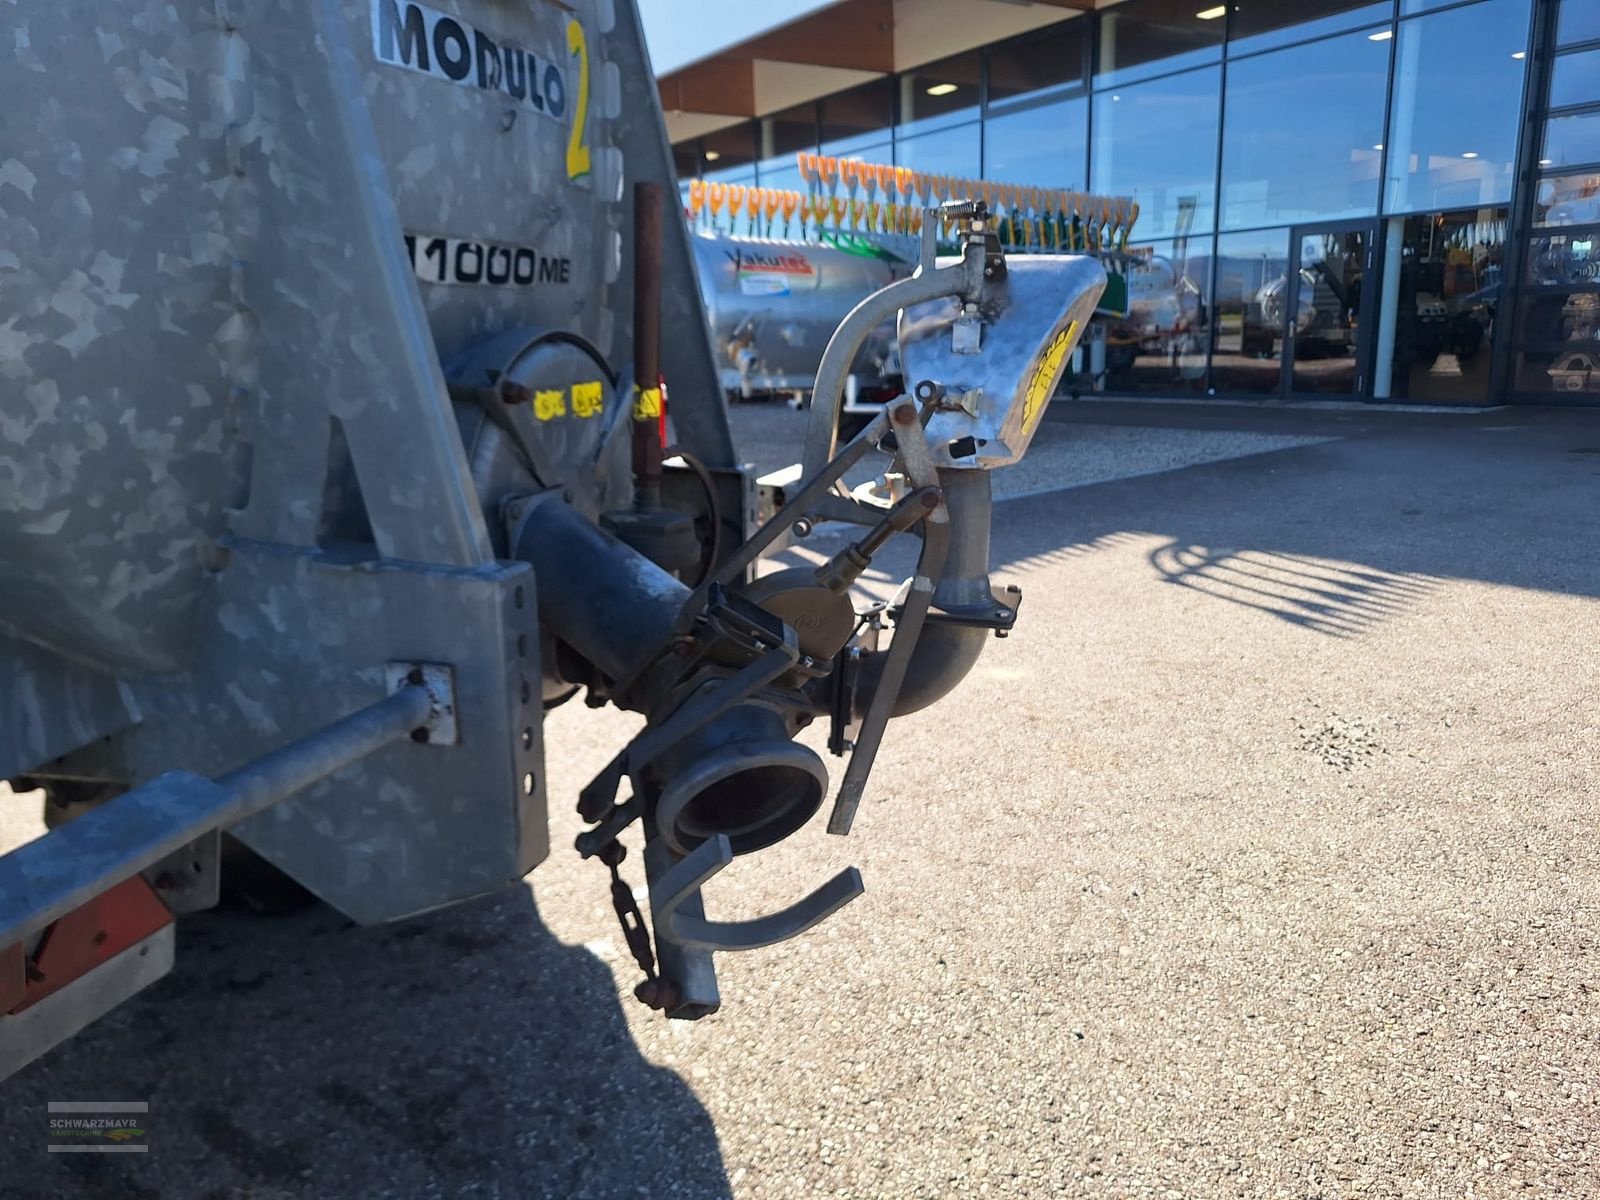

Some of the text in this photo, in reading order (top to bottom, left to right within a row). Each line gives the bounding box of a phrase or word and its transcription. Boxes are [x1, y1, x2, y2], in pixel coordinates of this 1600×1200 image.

[379, 0, 591, 180] MODULO 2
[538, 256, 571, 285] ME
